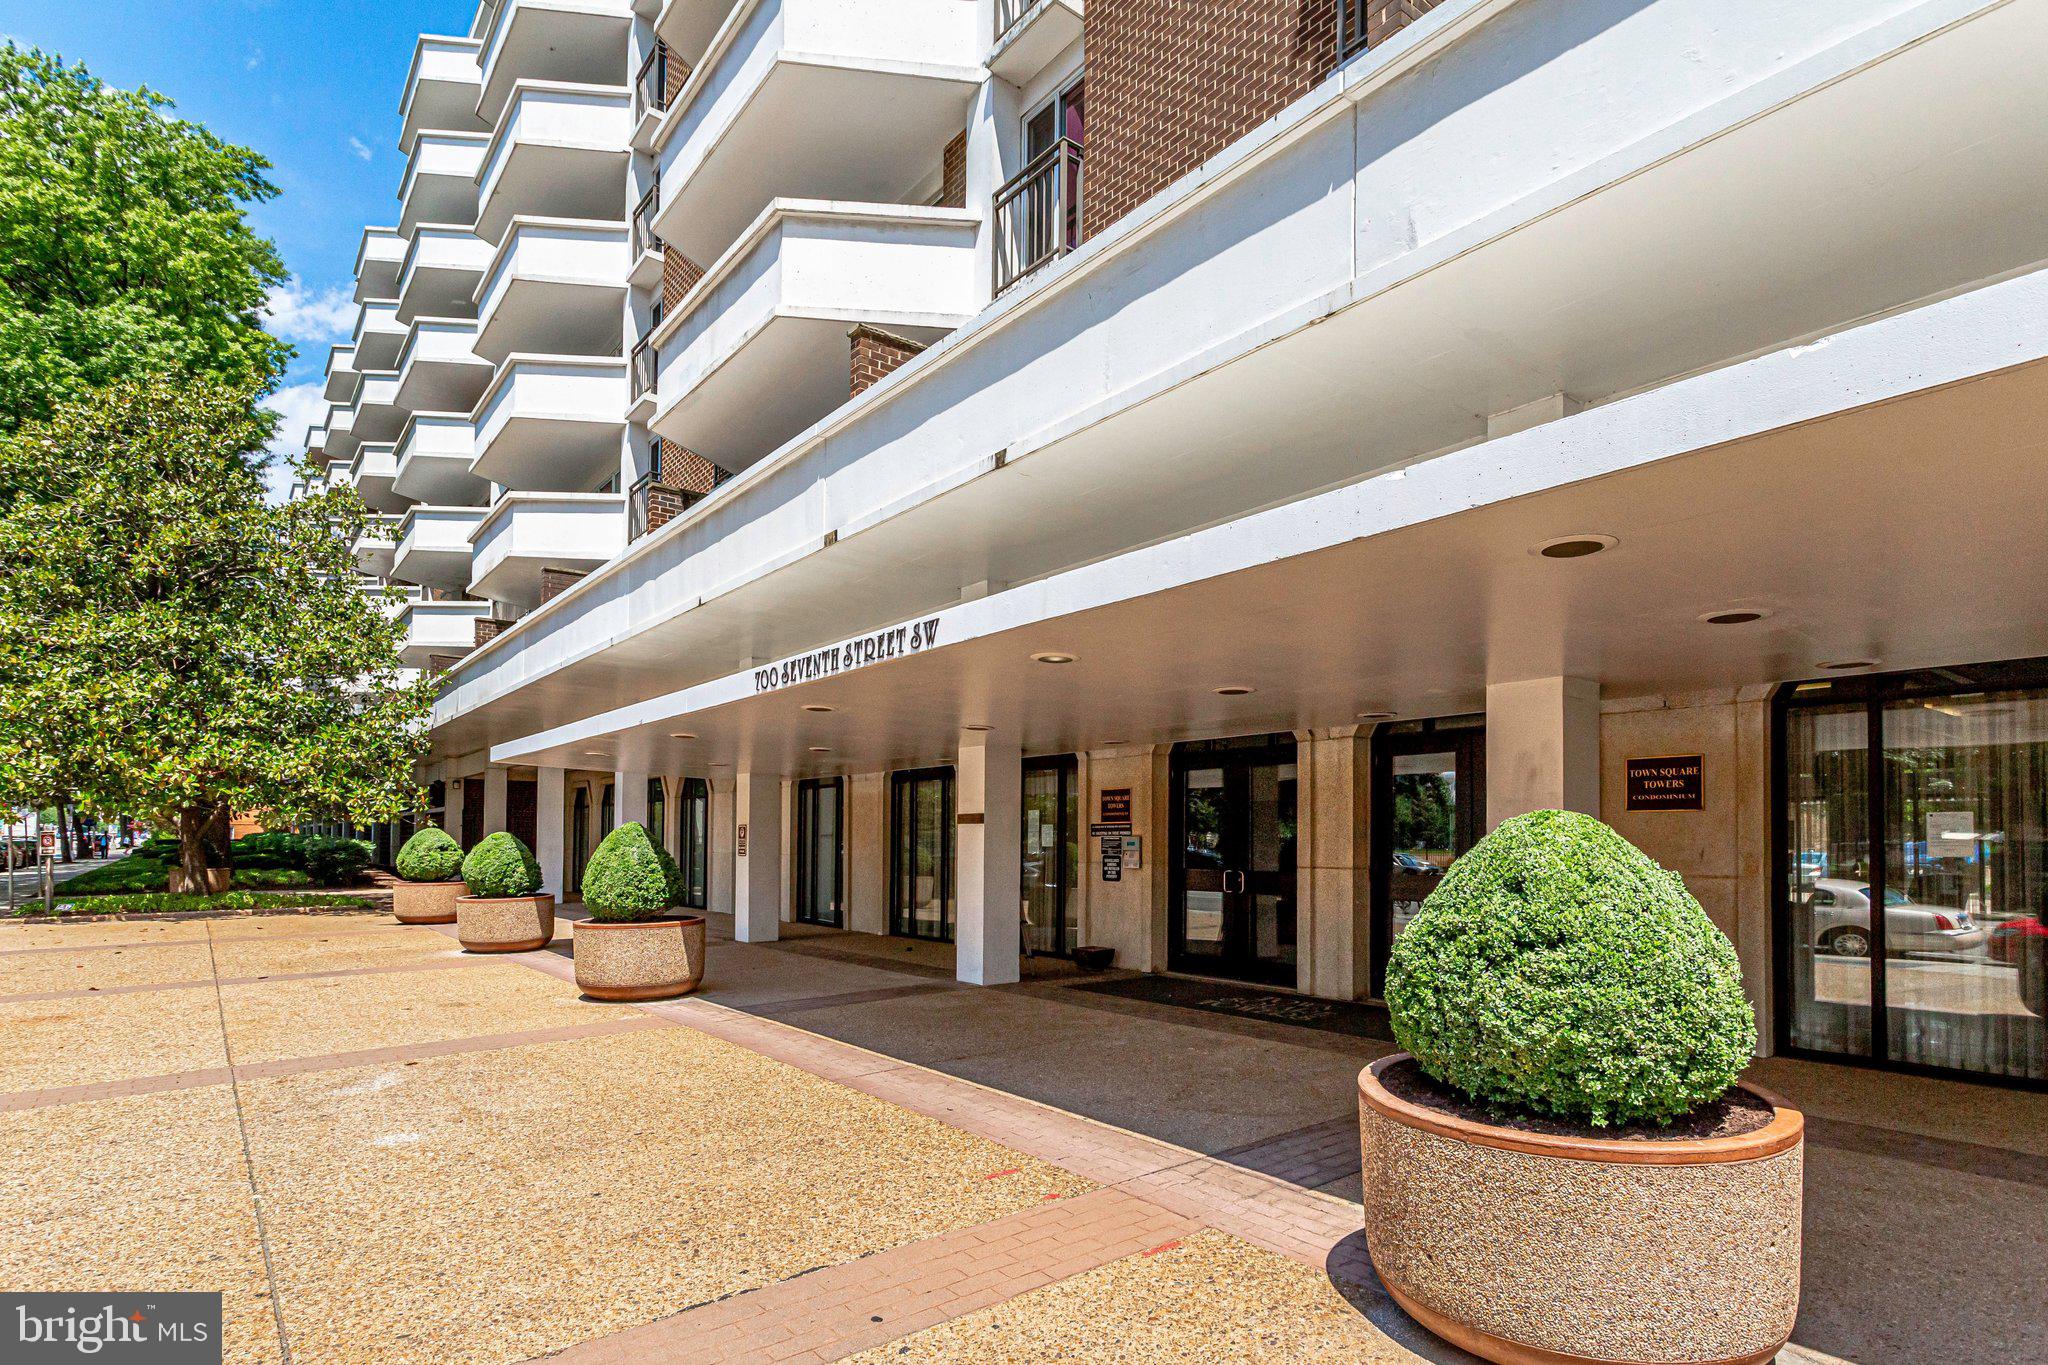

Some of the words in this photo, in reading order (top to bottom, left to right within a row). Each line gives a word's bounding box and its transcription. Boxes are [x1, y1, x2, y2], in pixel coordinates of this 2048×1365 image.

[755, 667, 778, 691] 700
[782, 647, 840, 684] SEVENTH
[843, 626, 906, 668] STREET
[911, 618, 940, 649] SW
[1630, 768, 1657, 778] TOWN
[1660, 767, 1699, 777] SQUARE
[1643, 780, 1685, 789] TOWERS
